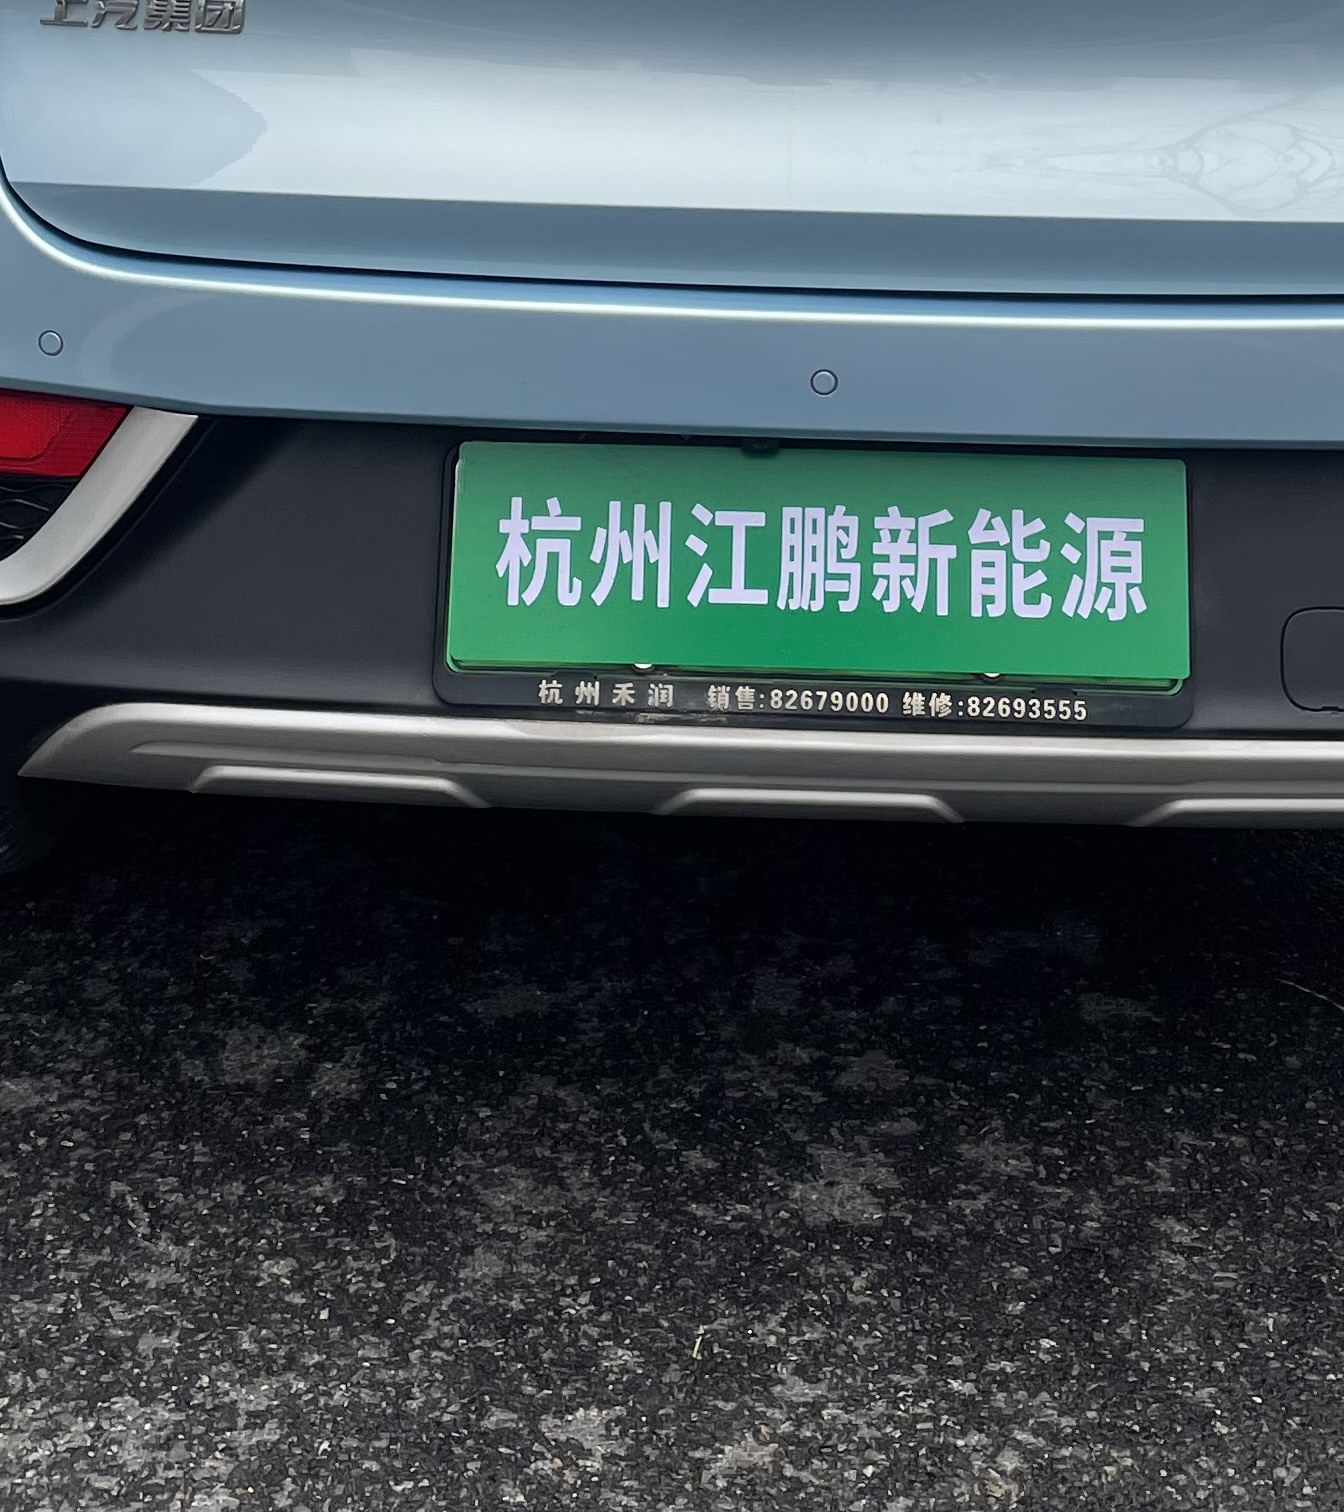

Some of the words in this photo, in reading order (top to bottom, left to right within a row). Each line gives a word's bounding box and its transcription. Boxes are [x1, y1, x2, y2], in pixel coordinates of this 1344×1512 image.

[495, 495, 1148, 621] 杭州江鹏新能源
[539, 679, 674, 708] 杭州禾润
